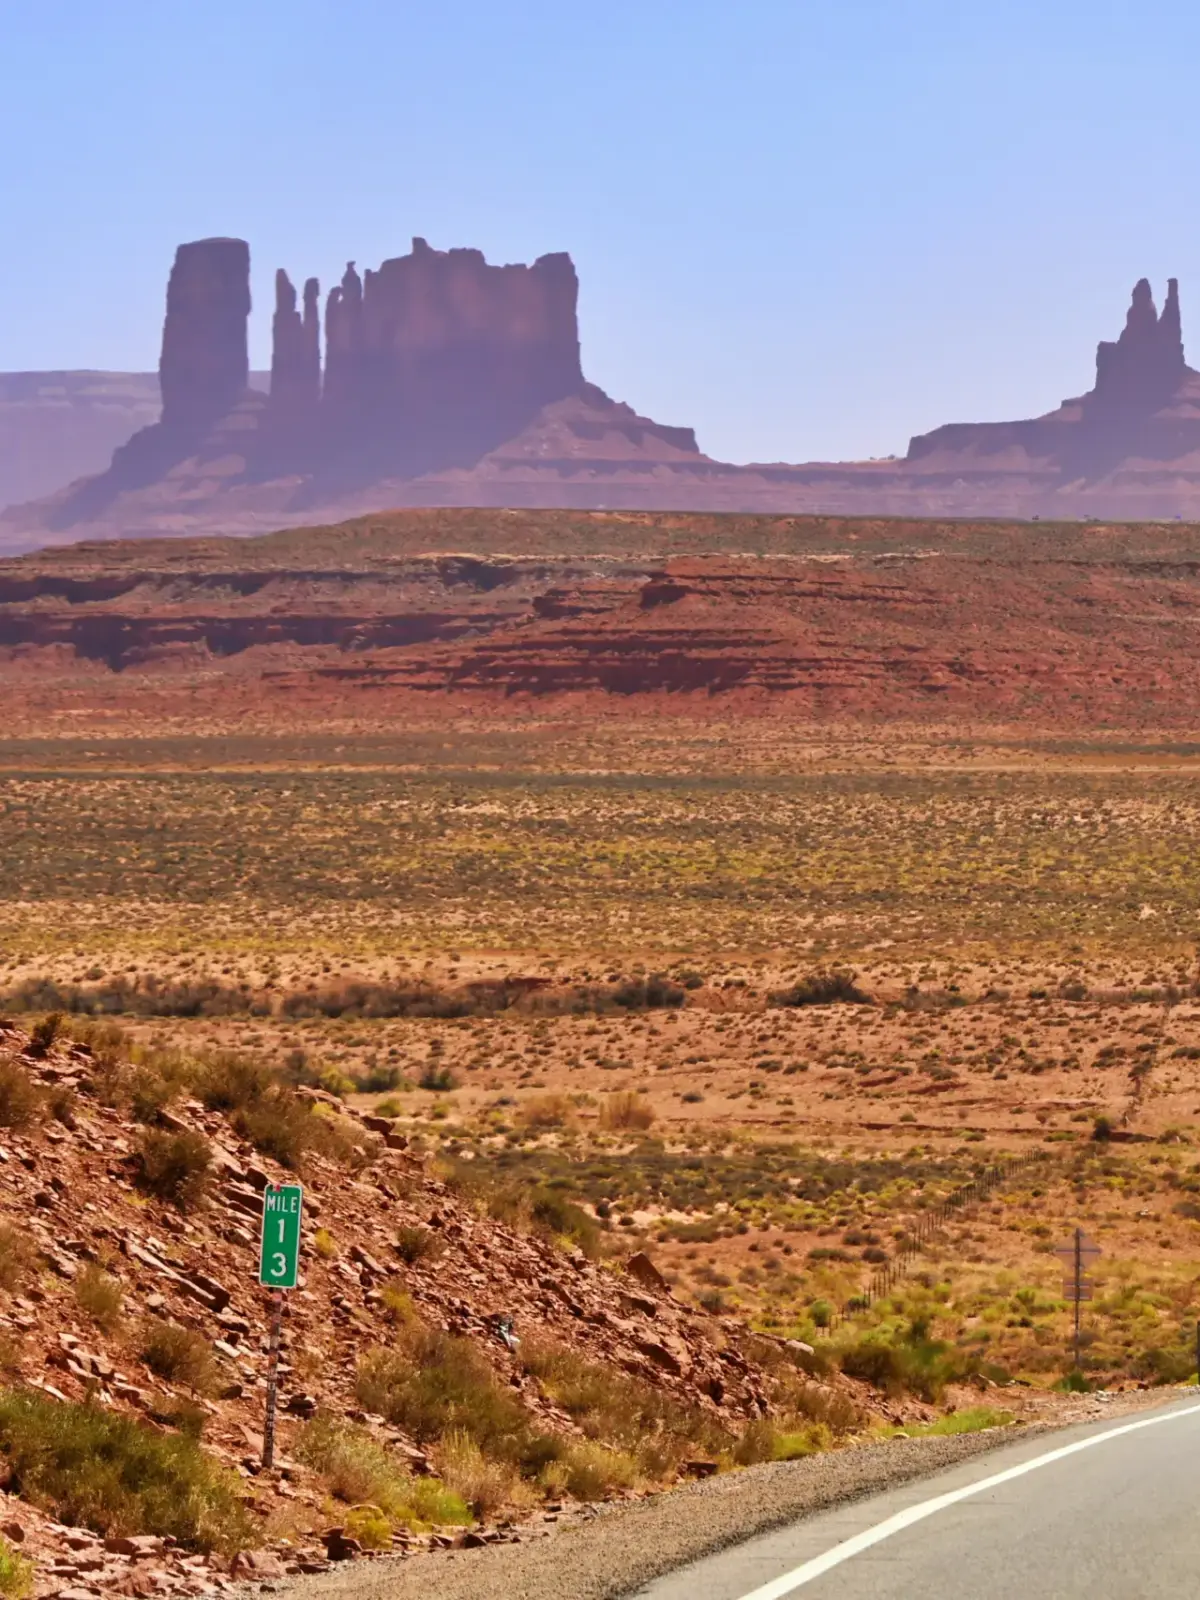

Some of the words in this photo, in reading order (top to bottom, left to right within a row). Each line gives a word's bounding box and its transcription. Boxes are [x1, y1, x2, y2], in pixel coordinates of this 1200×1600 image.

[267, 1195, 297, 1213] MILE
[277, 1218, 285, 1243] 1
[270, 1252, 286, 1277] 3
